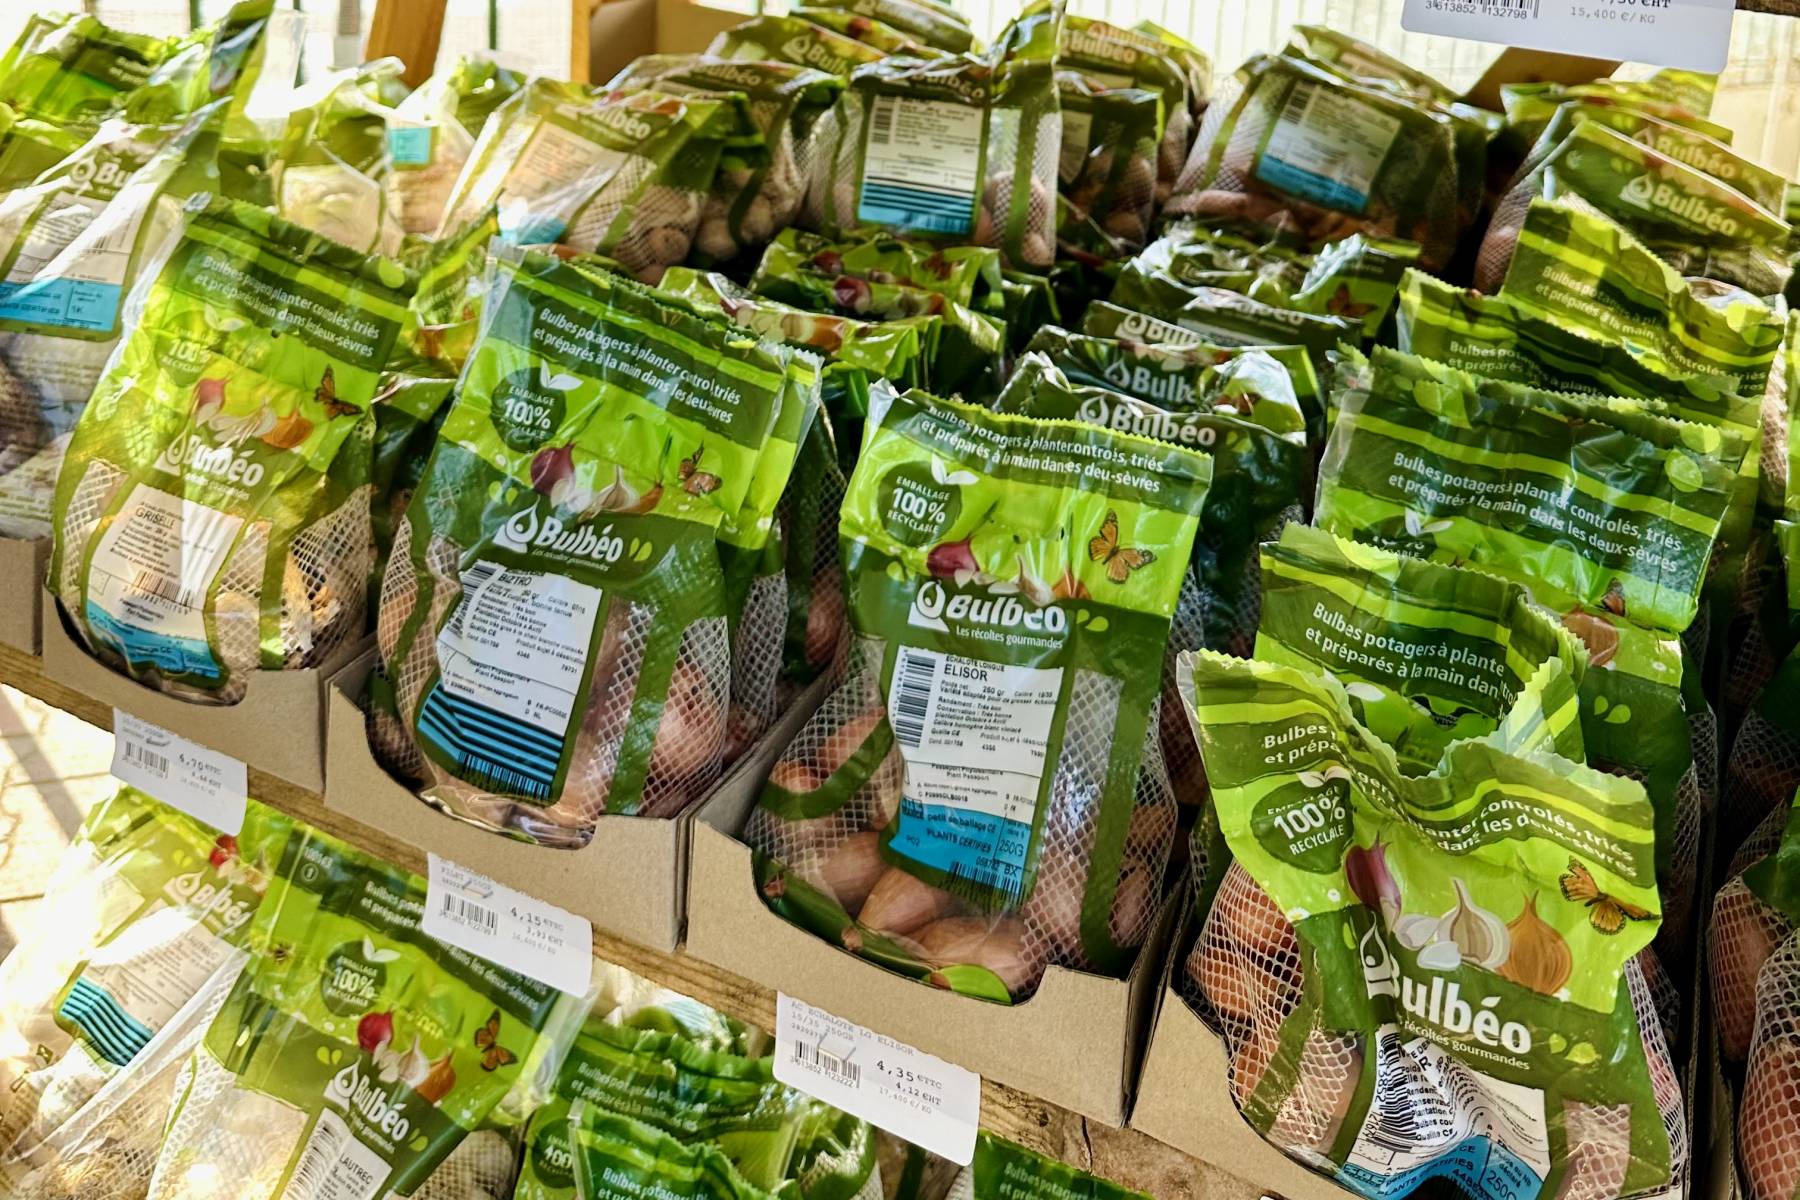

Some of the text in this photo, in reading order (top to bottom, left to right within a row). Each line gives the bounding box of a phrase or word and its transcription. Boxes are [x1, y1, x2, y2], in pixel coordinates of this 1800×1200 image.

[1570, 6, 1616, 21] 15,400
[1656, 136, 1737, 181] Bulbéo
[1652, 179, 1740, 238] Bulbéo
[203, 256, 379, 340] Bulbes triés
[534, 327, 671, 393] et préparés dans
[540, 308, 742, 405] Bulbes planter triés
[503, 398, 552, 430] 100%
[921, 420, 1040, 470] et préparés main
[1131, 453, 1164, 474] triés
[892, 487, 947, 524] 100%
[896, 475, 951, 501] EMBALLAGE
[1393, 452, 1683, 552] Bulbes potagers controlés, triés
[886, 509, 939, 534] RECYCLABLE
[1408, 478, 1678, 573] préparés main dans les deux-sèvres
[535, 516, 624, 563] Bulbéo
[956, 626, 1063, 650] Les récoltes gourmandes
[1312, 602, 1436, 660] Bulbes potagers
[944, 664, 989, 681] ELISOR
[1306, 627, 1464, 687] et préparés main
[1264, 724, 1328, 749] Bulbes
[1273, 795, 1346, 842] 100%
[1482, 813, 1513, 834] les
[1000, 839, 1024, 857] 250G
[1583, 831, 1635, 864] triés
[510, 906, 541, 926] 4,15
[332, 965, 375, 997] 100%
[1404, 1018, 1531, 1070] récoltes gourmandes
[876, 1060, 914, 1083] 4,35
[357, 1071, 410, 1143] Bulbéo
[339, 1152, 375, 1186] LAUTREC
